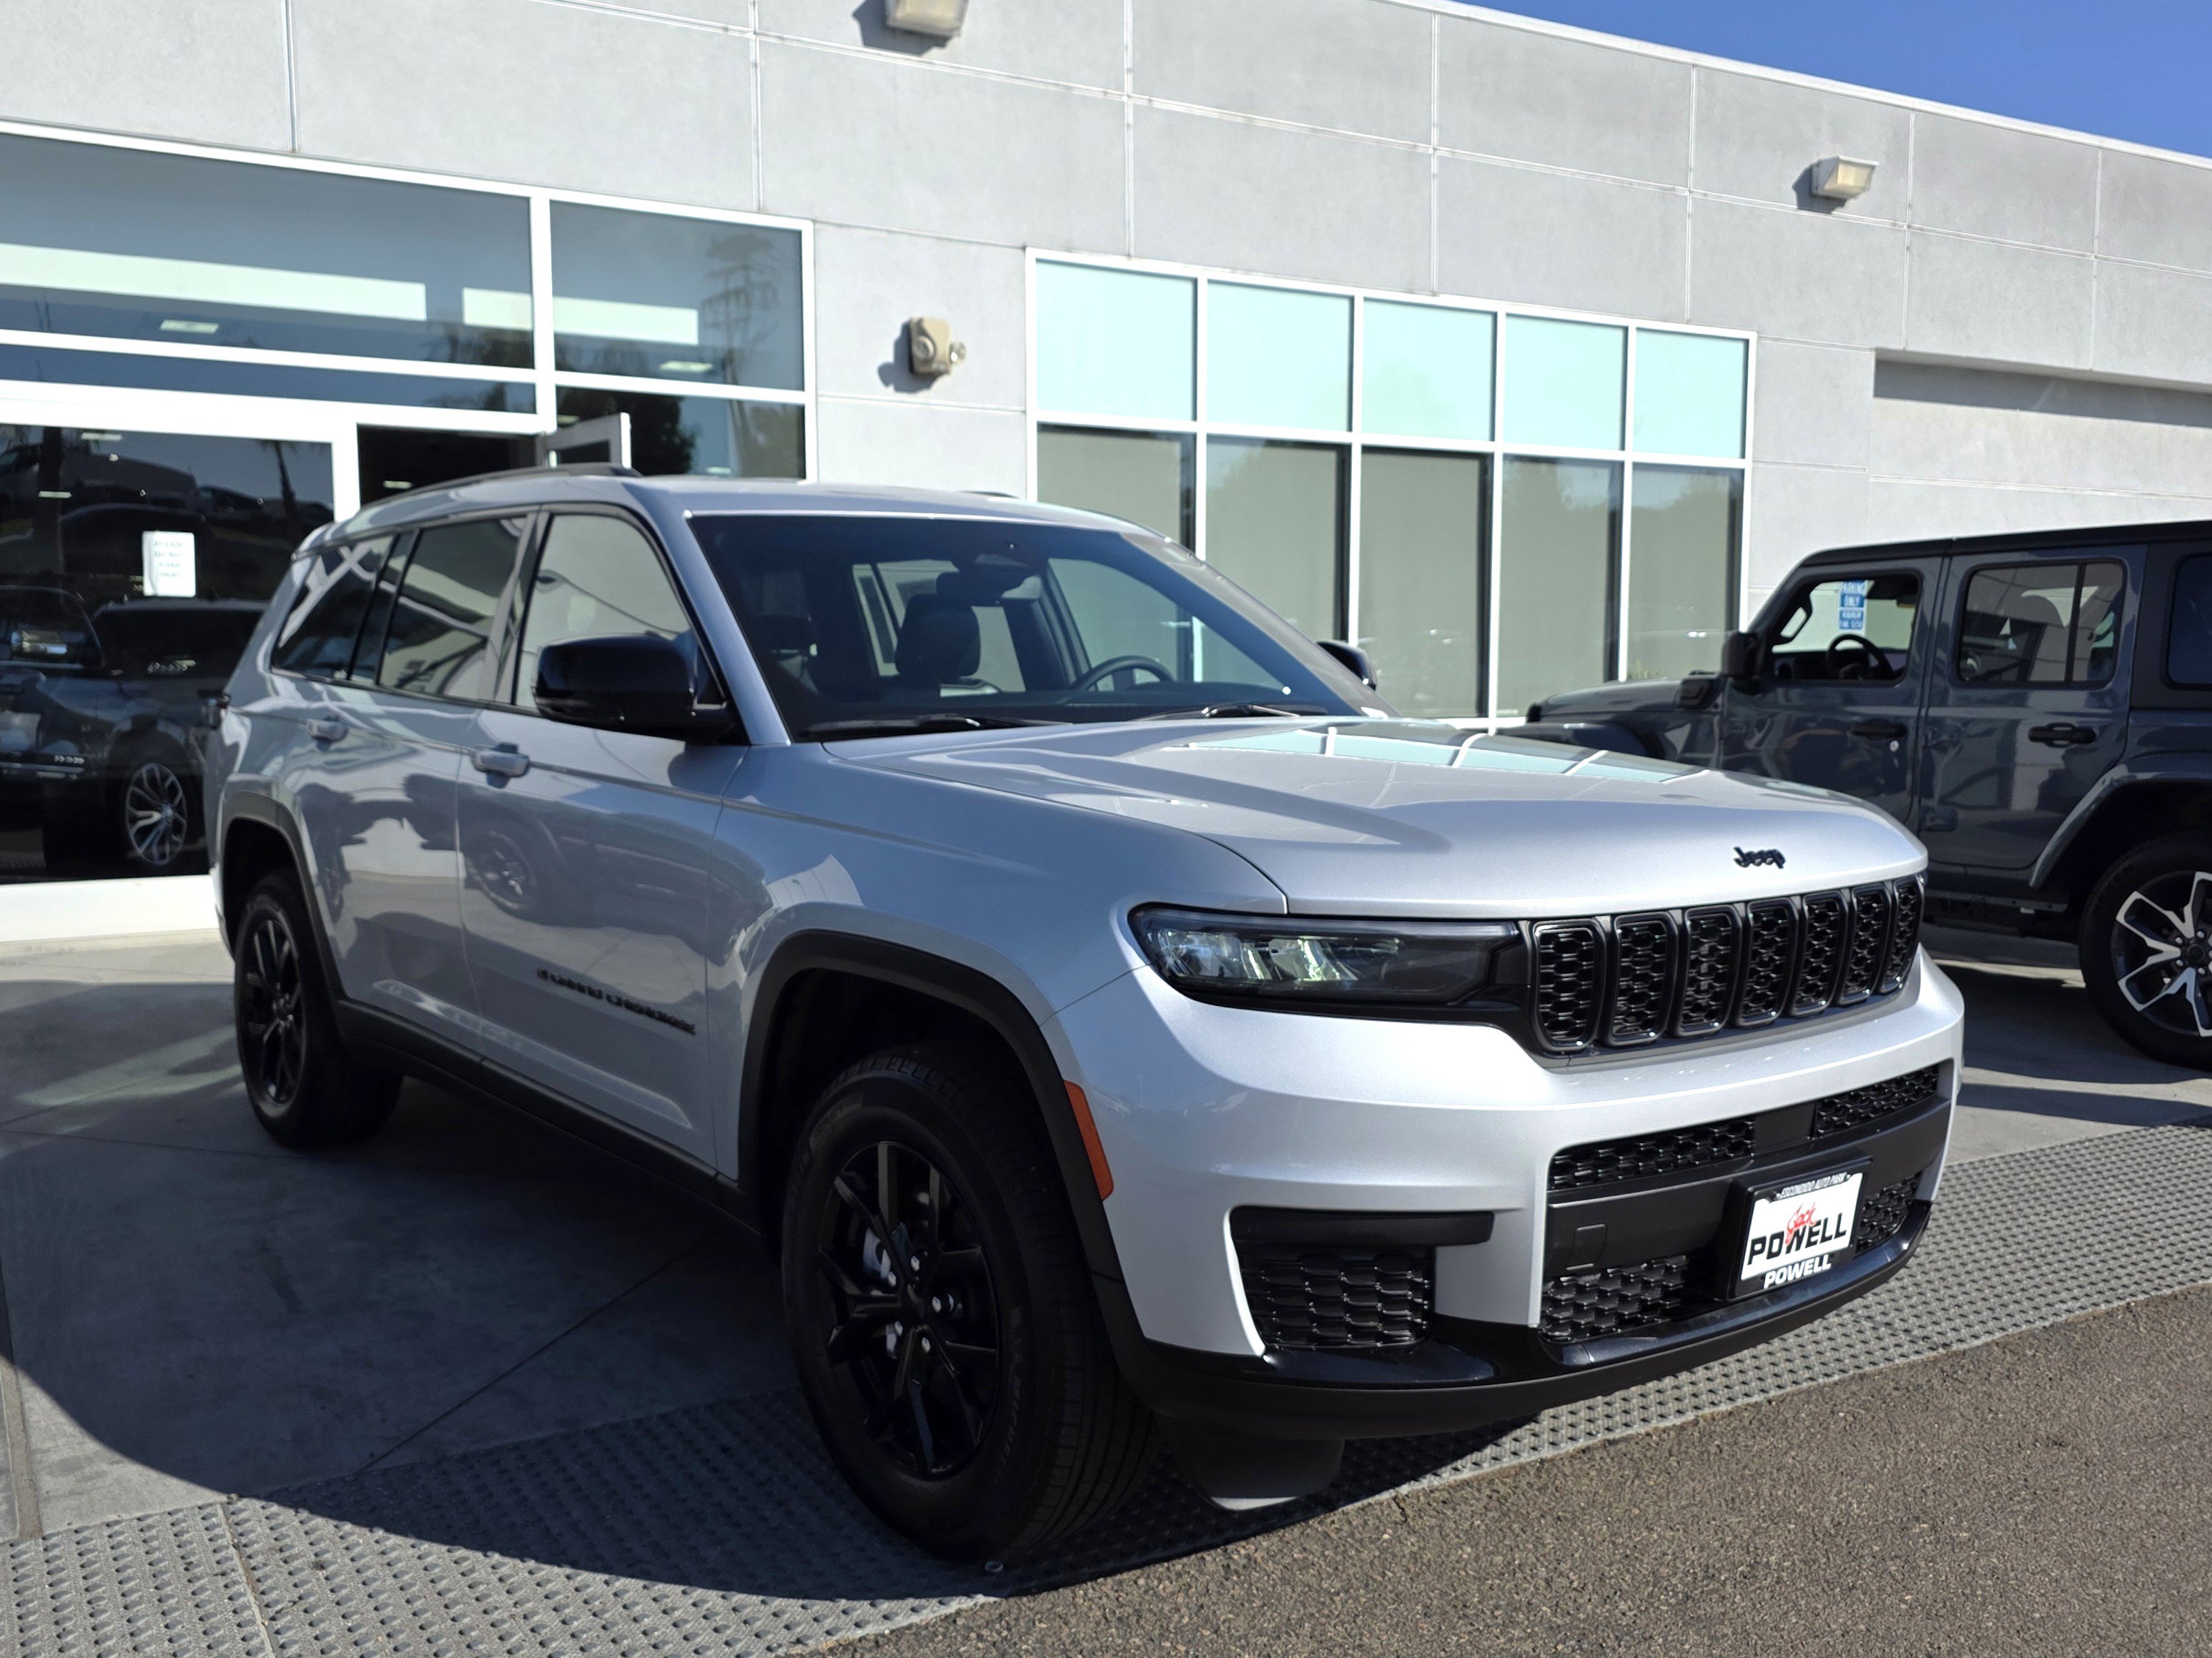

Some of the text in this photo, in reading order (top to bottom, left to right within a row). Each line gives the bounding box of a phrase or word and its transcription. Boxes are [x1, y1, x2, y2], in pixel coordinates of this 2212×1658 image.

[1733, 846, 1785, 869] Jeep
[1747, 1213, 1847, 1265] POWELL
[1763, 1254, 1832, 1290] POWELL
